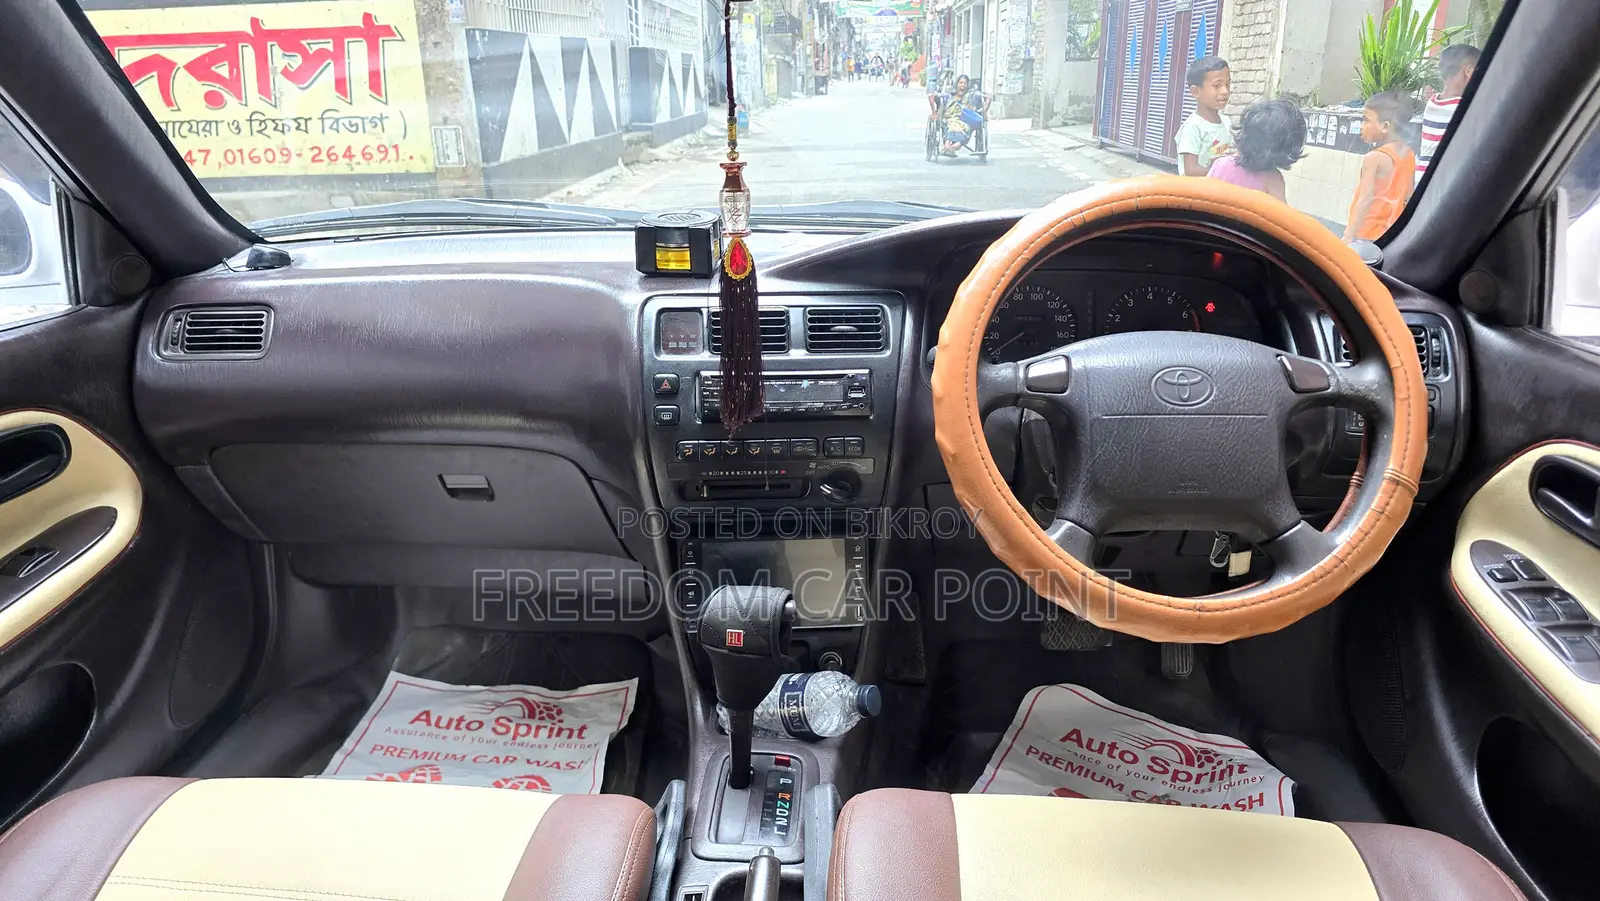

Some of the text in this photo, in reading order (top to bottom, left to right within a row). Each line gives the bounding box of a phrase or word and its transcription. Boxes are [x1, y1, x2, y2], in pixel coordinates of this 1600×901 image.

[227, 119, 242, 135] ও
[320, 108, 390, 138] বিভাগ
[1013, 293, 1024, 301] 80
[1030, 293, 1044, 301] 100
[1047, 301, 1060, 309] 120
[1054, 315, 1068, 323] 140
[989, 332, 1000, 340] 20
[1056, 331, 1069, 339] 160
[408, 709, 589, 740] Auto Sprint
[384, 726, 600, 751] Assurance of your endless journey
[369, 744, 468, 763] PREMIUM
[1059, 728, 1140, 765] Auto
[1147, 756, 1251, 785] Sprint
[1025, 745, 1125, 792] PREMIUM
[1106, 763, 1265, 794] of your endless journey
